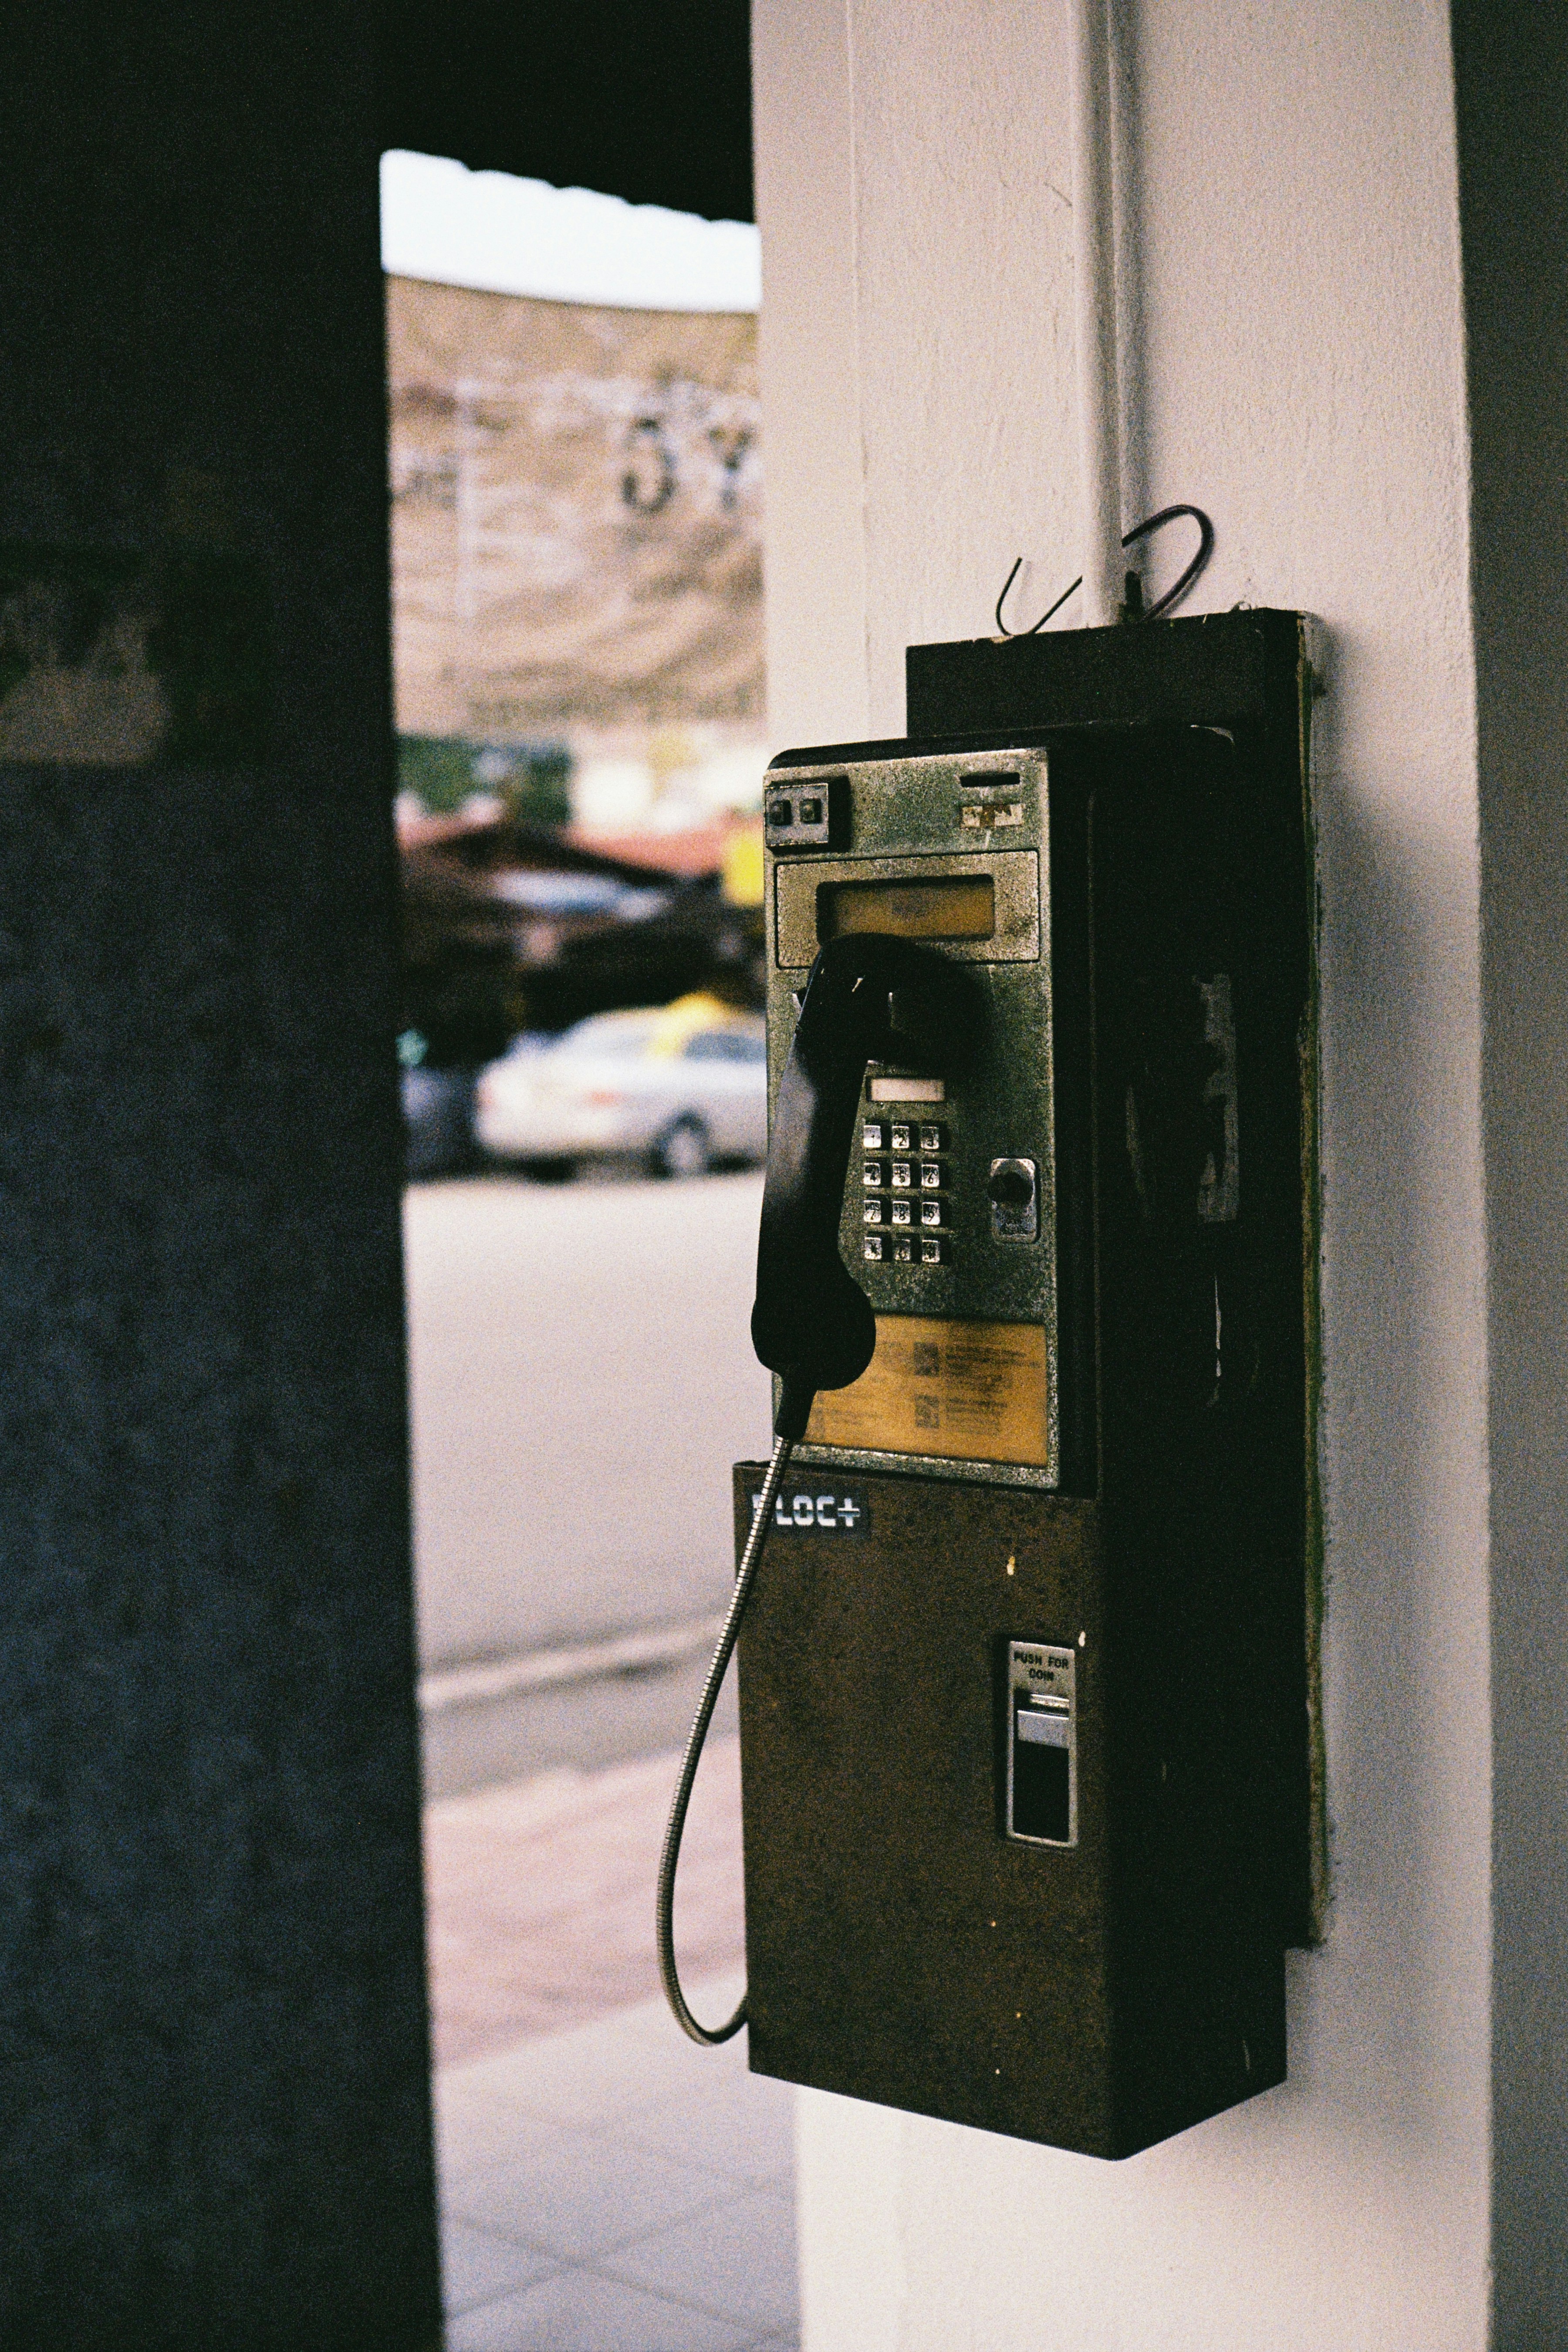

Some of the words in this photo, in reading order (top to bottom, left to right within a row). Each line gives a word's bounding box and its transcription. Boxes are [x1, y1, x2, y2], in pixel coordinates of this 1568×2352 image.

[1014, 1651, 1042, 1665] PUSH
[1048, 1656, 1069, 1669] FOR
[1029, 1668, 1054, 1681] COIN
